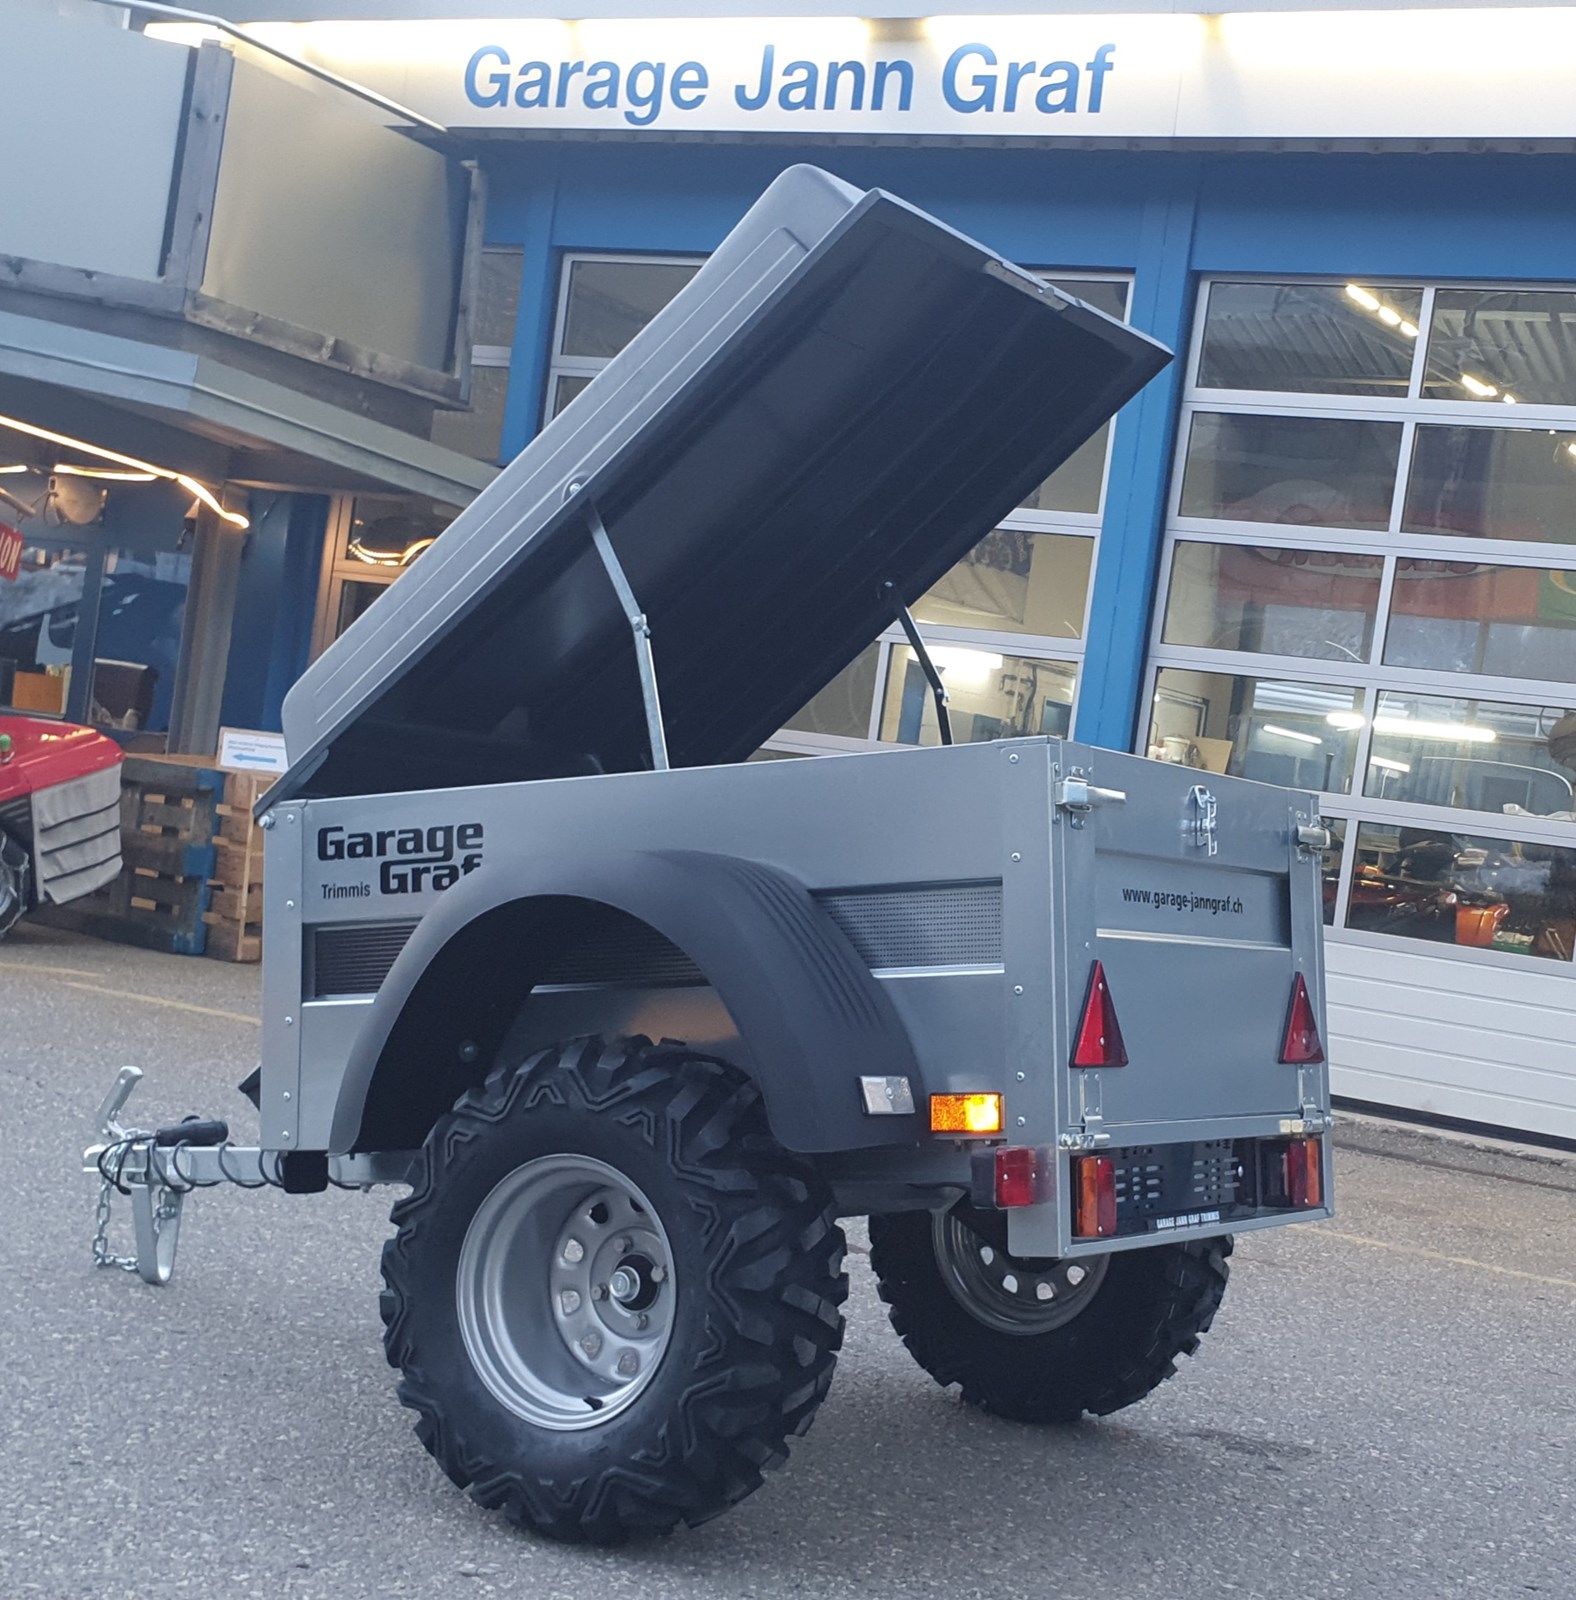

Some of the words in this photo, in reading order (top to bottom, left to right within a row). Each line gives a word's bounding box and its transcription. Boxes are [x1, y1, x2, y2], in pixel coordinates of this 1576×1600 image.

[463, 44, 709, 125] Garage
[734, 43, 914, 112] Jann
[941, 42, 1116, 114] Graf
[317, 822, 484, 862] Garage
[321, 881, 371, 899] Trimmis
[1122, 887, 1244, 915] www.garage-janngraf.ch
